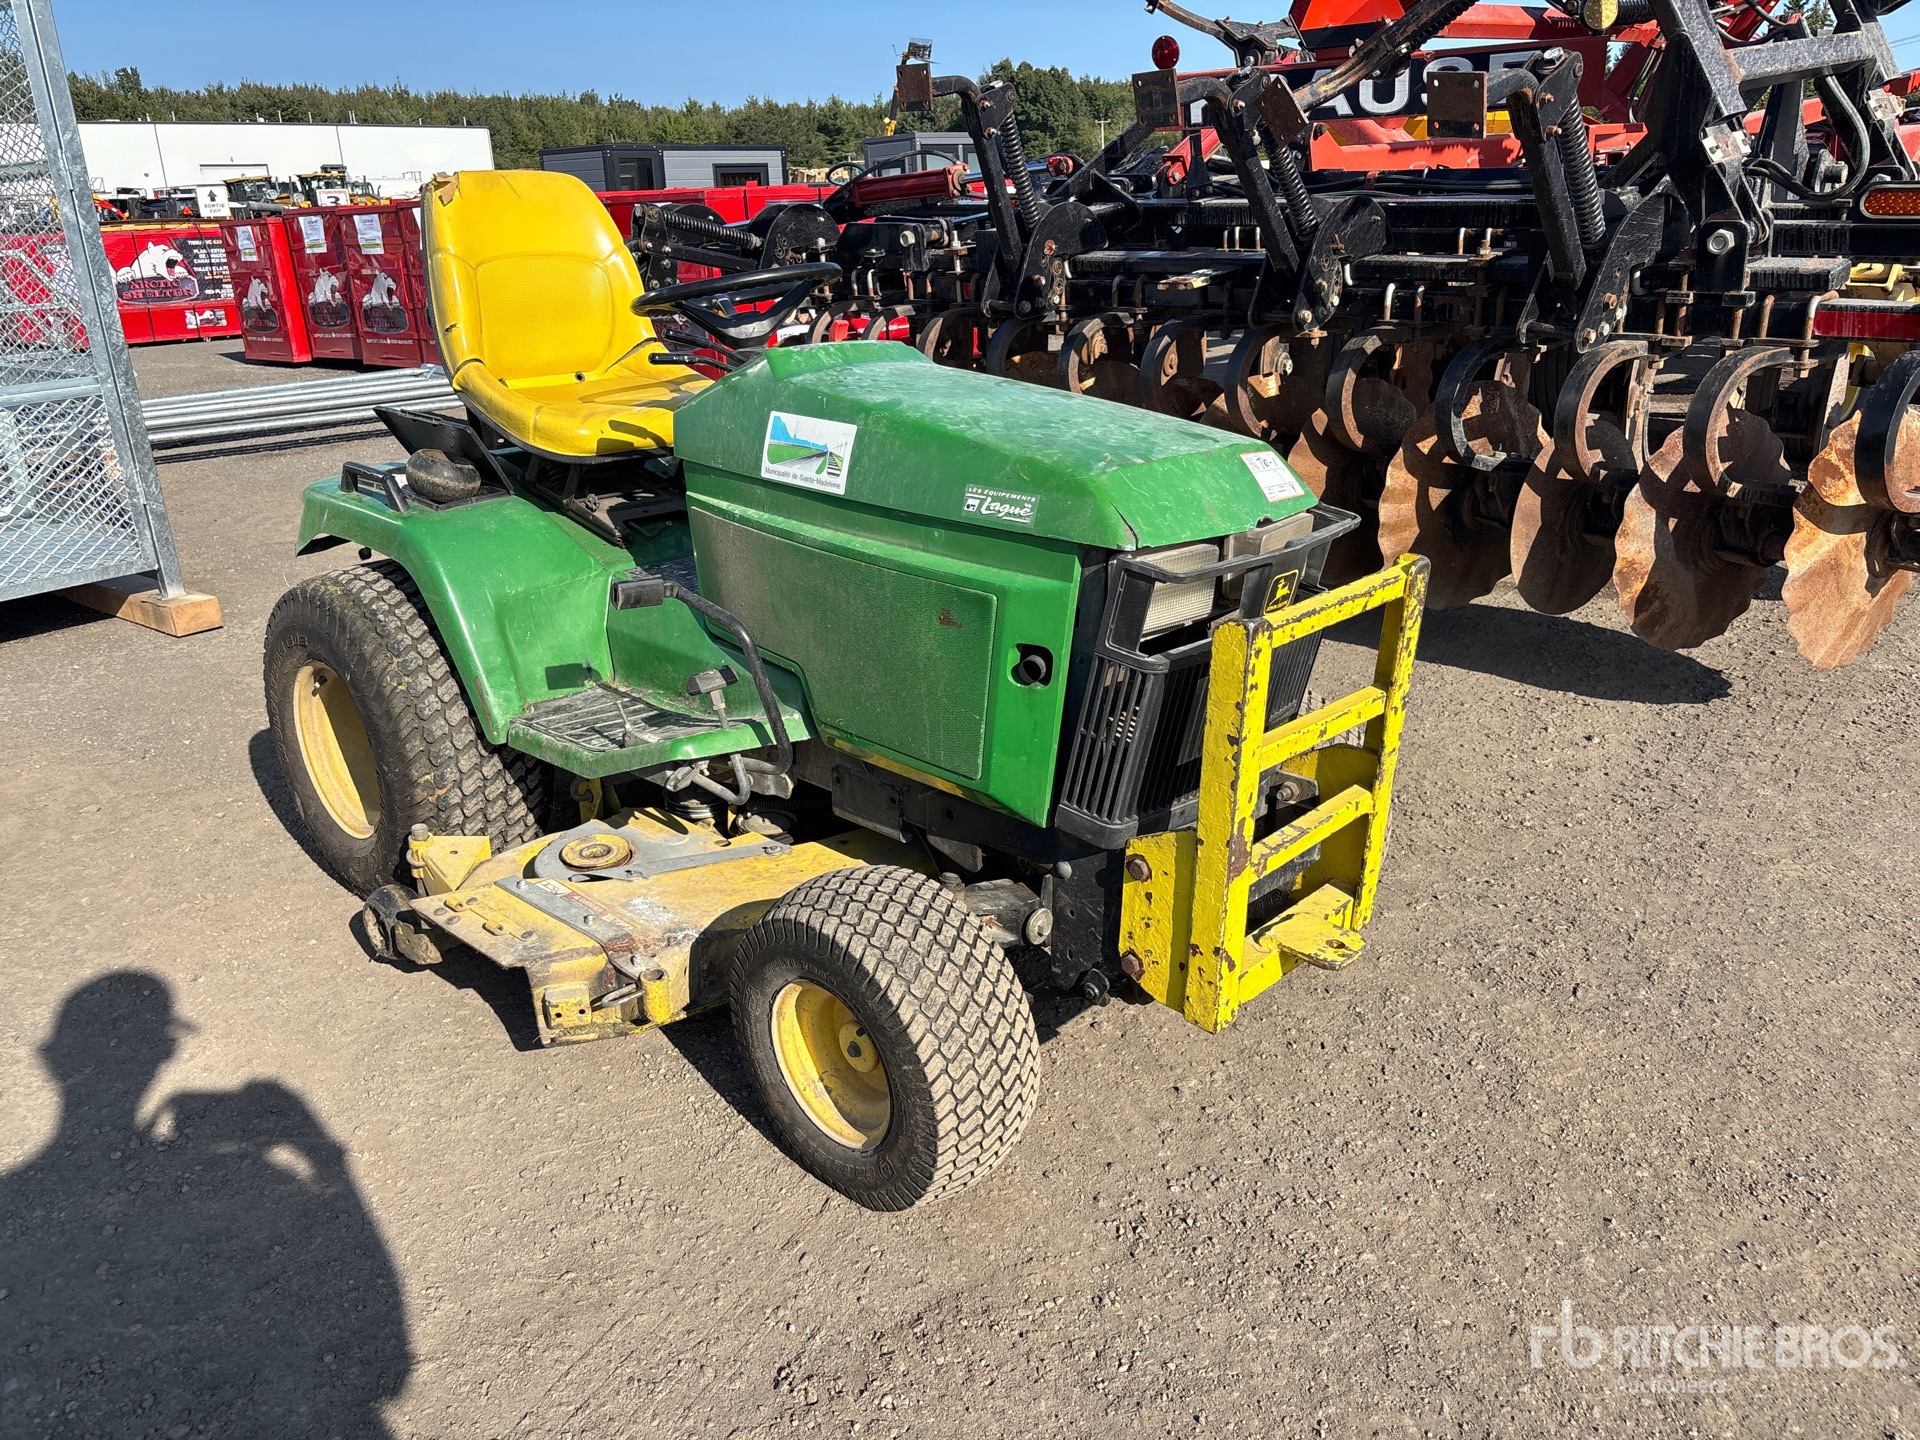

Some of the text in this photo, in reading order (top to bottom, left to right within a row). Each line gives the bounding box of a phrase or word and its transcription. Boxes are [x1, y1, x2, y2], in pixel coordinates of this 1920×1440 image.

[130, 279, 182, 290] ARCTIC
[122, 288, 194, 300] SHELTER
[764, 466, 841, 490] Municipalité de Sainte-Madeleine
[968, 486, 983, 494] LES
[1265, 604, 1278, 612] JOHN
